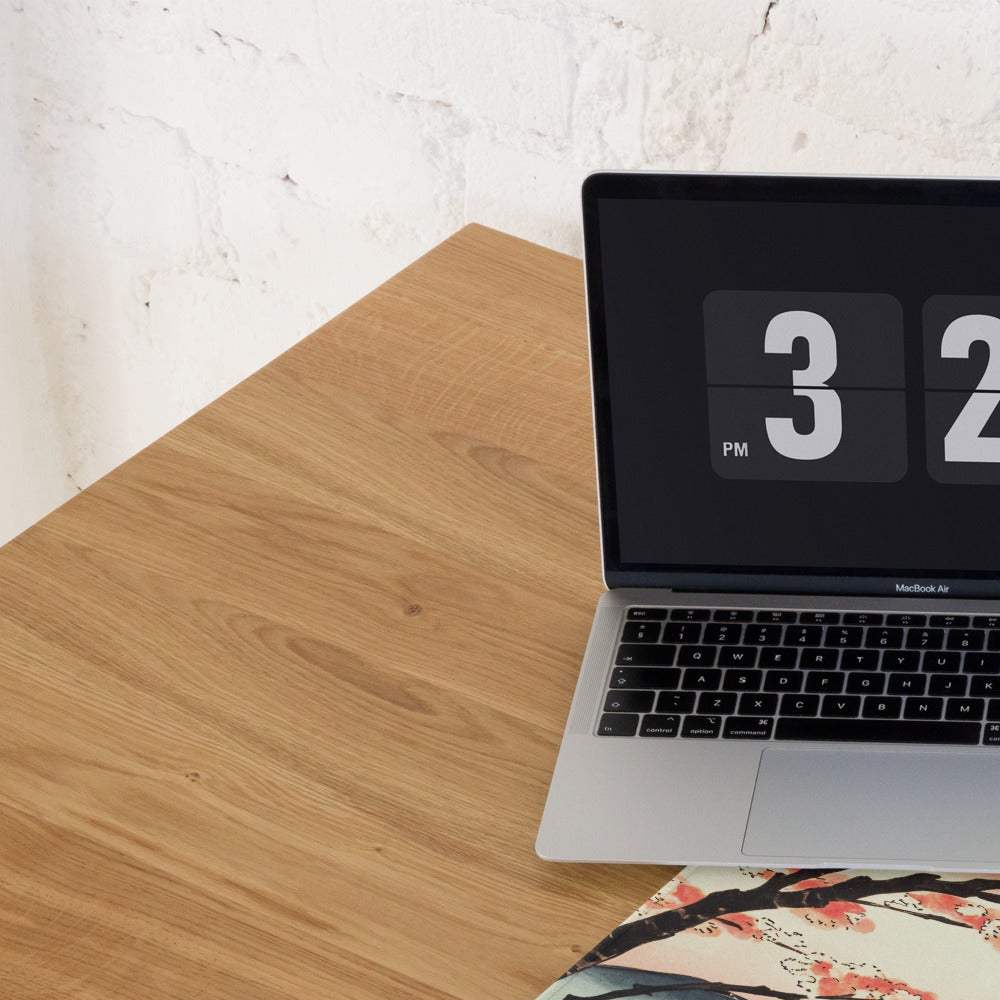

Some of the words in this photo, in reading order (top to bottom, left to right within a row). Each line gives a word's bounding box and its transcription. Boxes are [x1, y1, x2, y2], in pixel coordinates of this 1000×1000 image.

[764, 310, 843, 461] 3
[722, 441, 749, 457] PM
[895, 583, 936, 593] MacBook
[937, 584, 950, 593] Air
